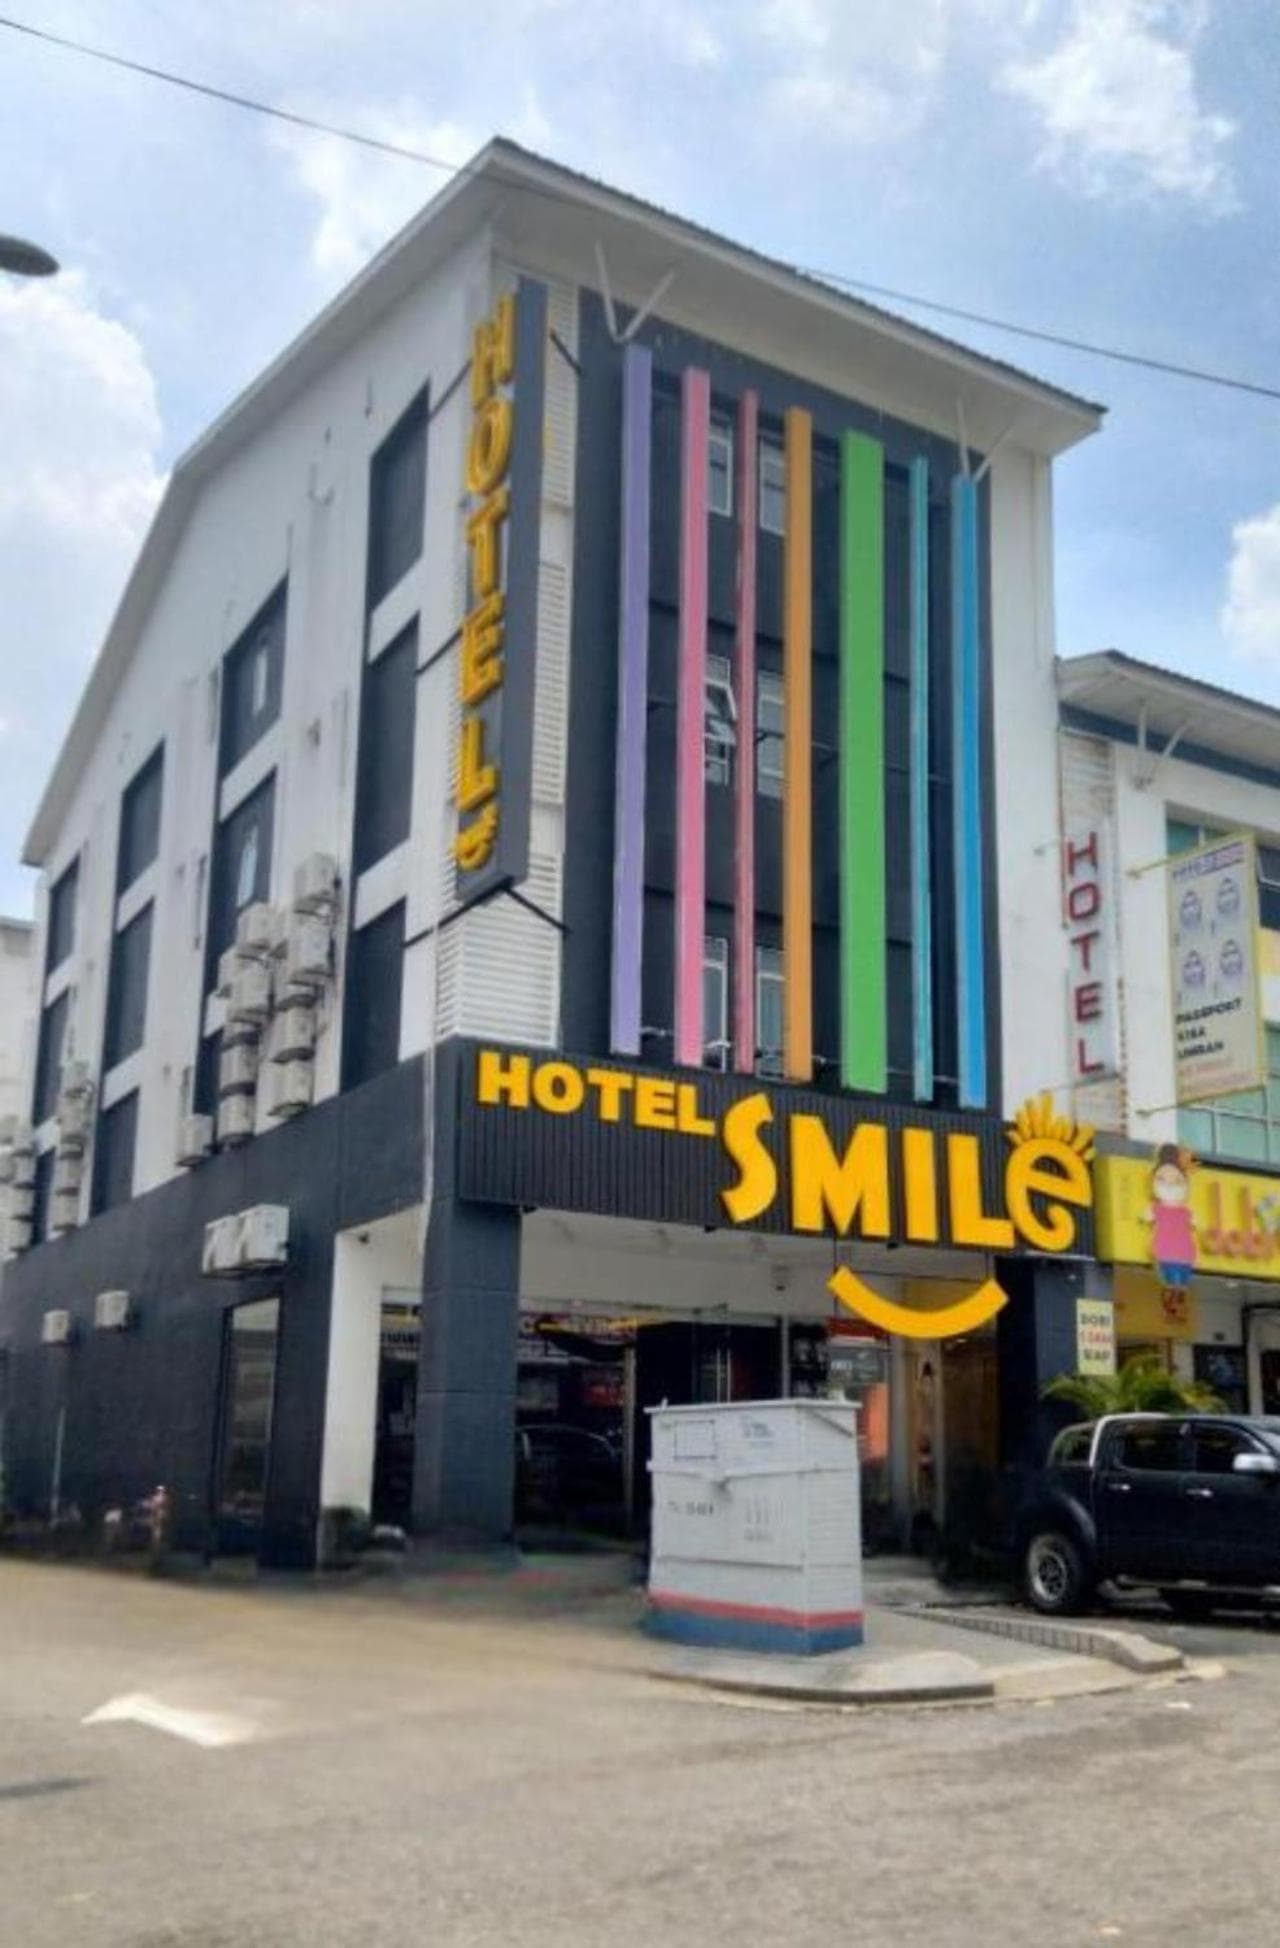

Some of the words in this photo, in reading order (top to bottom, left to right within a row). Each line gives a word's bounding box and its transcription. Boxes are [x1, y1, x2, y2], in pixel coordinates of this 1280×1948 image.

[457, 293, 514, 811] HOTEL
[1066, 831, 1104, 1075] HOTEL
[478, 1050, 715, 1137] HOTEL
